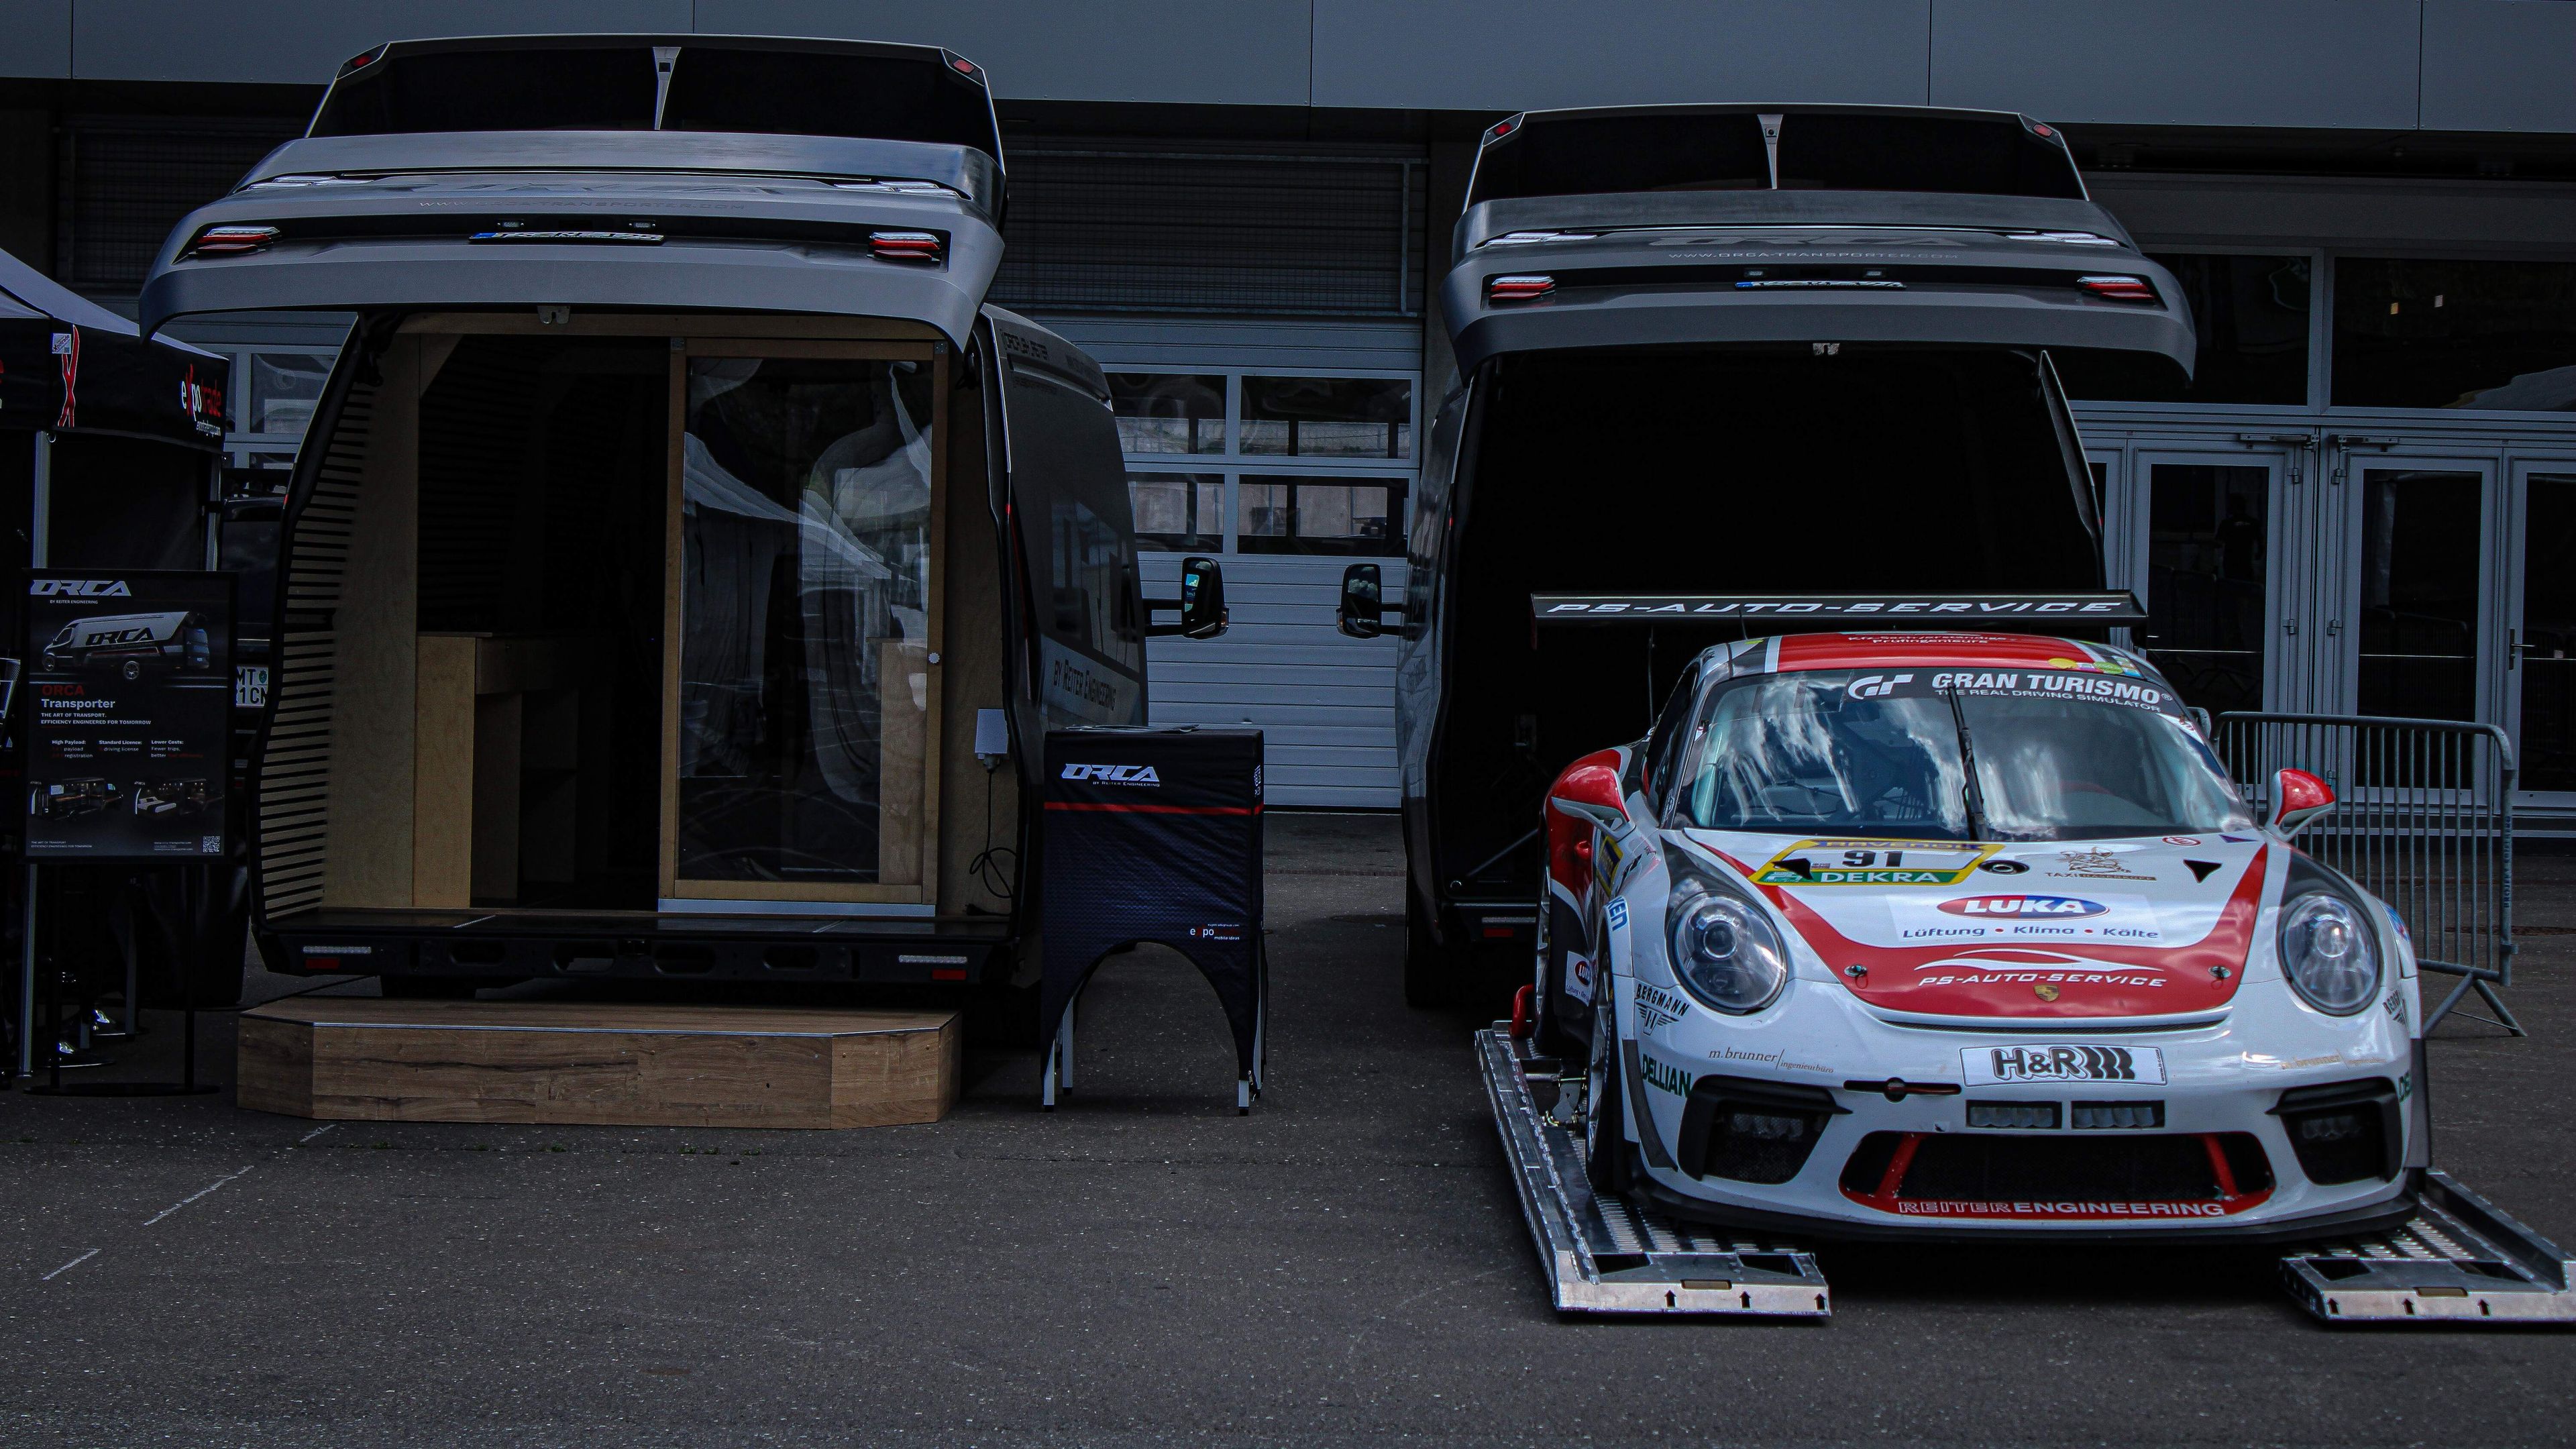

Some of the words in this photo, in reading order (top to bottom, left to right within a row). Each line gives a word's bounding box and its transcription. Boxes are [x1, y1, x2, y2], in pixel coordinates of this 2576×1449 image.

[30, 579, 132, 596] ORCA
[1546, 602, 2122, 613] PS-AUTO-SERVICE
[86, 627, 155, 645] ORCA
[1063, 659, 1084, 698] REITER
[1084, 670, 1117, 711] ENGINEERING
[1932, 673, 2019, 689] GRAN
[42, 684, 85, 696] ORCA
[41, 698, 116, 710] Transporter
[2012, 690, 2073, 700] DRIVING
[2077, 694, 2161, 712] SIMULATOR
[1061, 763, 1160, 782] ORCA
[1843, 850, 1904, 868] 91
[1820, 872, 1940, 883] DEKRA
[1964, 900, 2086, 914] LUKA
[1903, 926, 1986, 938] Lüftung
[2014, 926, 2075, 935] Klima
[2102, 927, 2159, 938] Kälte
[1918, 973, 2168, 987] PS-AUTO-SERVICE
[1636, 983, 1691, 1017] BERGMANN
[1991, 1048, 2083, 1077] H&R
[1642, 1053, 1693, 1099] DELLIAN
[1898, 1201, 2012, 1214] REITER
[2013, 1201, 2226, 1216] ENGINEERING
